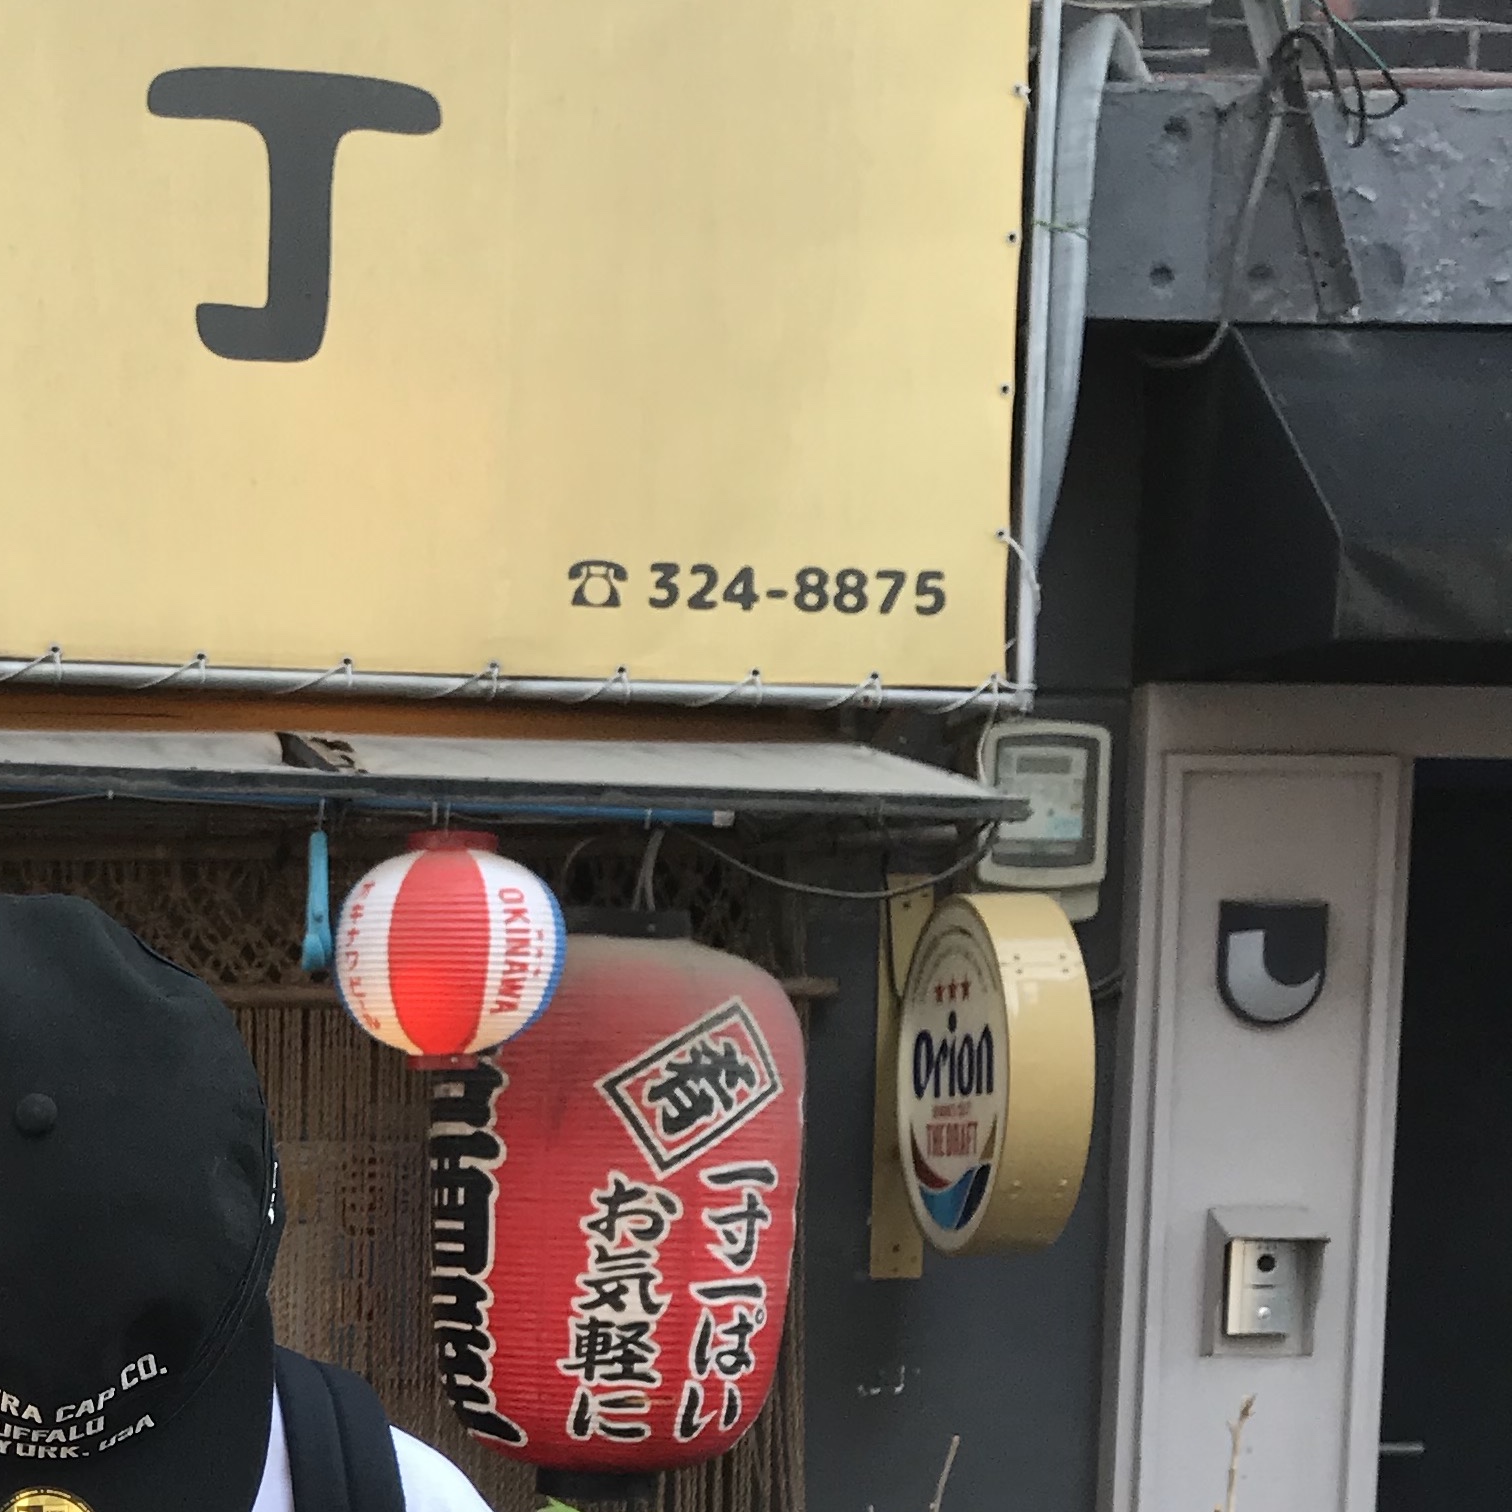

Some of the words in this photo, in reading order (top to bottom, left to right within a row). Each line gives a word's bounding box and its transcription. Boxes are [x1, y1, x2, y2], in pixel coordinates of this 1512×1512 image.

[648, 561, 948, 616] 324-8875
[343, 880, 381, 1030] オキナワビール
[489, 886, 532, 1015] OKINAWA
[558, 1174, 678, 1439] お気軽に
[56, 1387, 116, 1423] CAP
[121, 1353, 168, 1391] CO.
